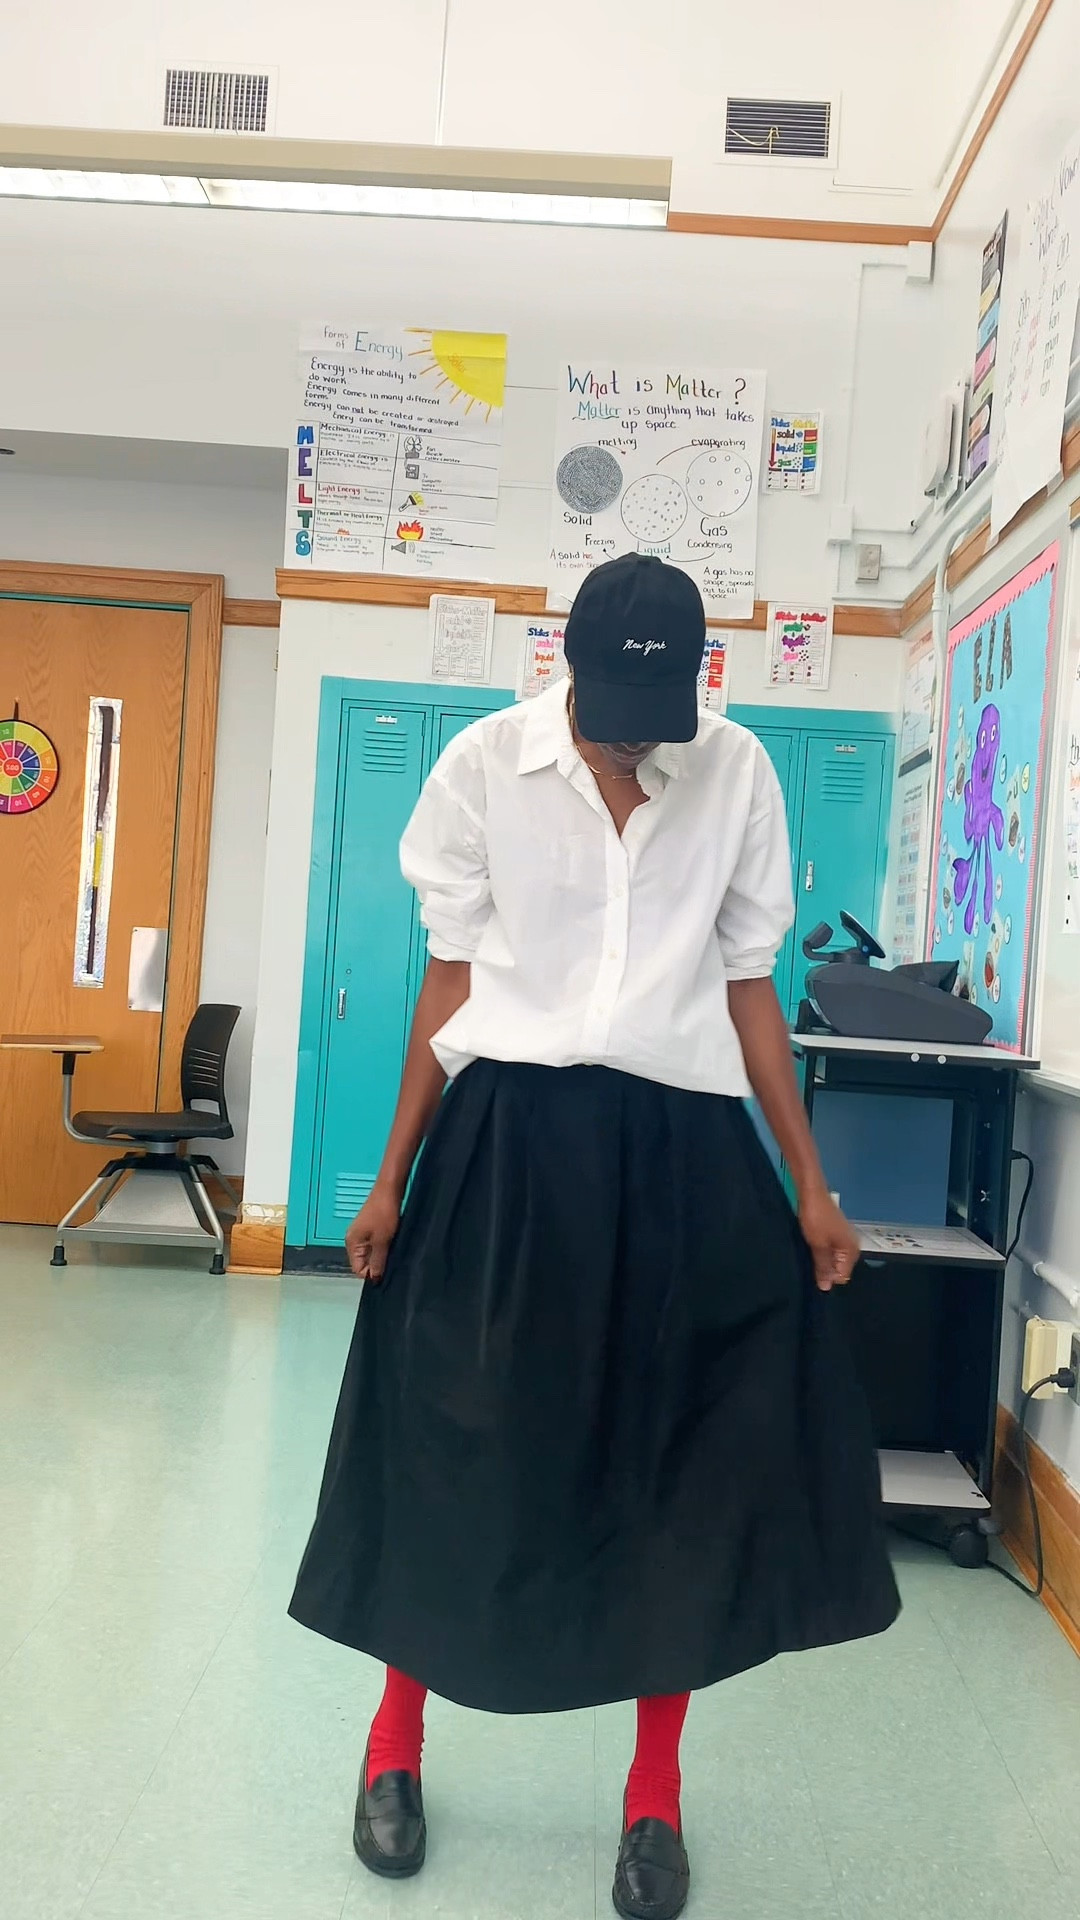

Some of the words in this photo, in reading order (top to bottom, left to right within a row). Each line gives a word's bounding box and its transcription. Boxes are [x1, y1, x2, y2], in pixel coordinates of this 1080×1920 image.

[354, 331, 403, 362] Energy
[310, 356, 345, 376] Energy
[361, 366, 375, 376] the
[376, 369, 404, 384] ability
[409, 372, 417, 380] to
[308, 373, 320, 381] do
[323, 376, 347, 385] work
[567, 365, 620, 400] What
[636, 377, 653, 392] is
[665, 374, 722, 401] Matter
[734, 377, 747, 405] ?
[307, 381, 337, 395] Energy
[342, 388, 368, 398] comes
[380, 394, 404, 404] many
[406, 394, 440, 405] different
[304, 399, 332, 411] Energy
[368, 407, 379, 415] be
[381, 411, 413, 421] created
[427, 417, 459, 427] destroyed
[575, 401, 622, 421] Matter
[628, 408, 641, 416] is
[646, 405, 692, 420] anything
[695, 406, 717, 418] that
[726, 407, 755, 424] takes
[374, 417, 385, 425] be
[621, 420, 638, 434] up
[297, 425, 315, 445] M
[776, 428, 796, 439] solid
[597, 438, 637, 451] melting
[776, 442, 796, 455] liquid
[320, 449, 356, 458] Electrical
[298, 447, 313, 477] E
[298, 483, 314, 504] L
[337, 486, 361, 495] Energy
[297, 509, 314, 528] T
[563, 511, 593, 527] Solid
[700, 516, 728, 537] Gas
[294, 530, 312, 557] S
[585, 533, 616, 550] Freezing
[636, 540, 671, 556] Liquid
[687, 538, 733, 554] Condensing
[549, 548, 557, 561] A
[703, 565, 711, 576] A
[712, 568, 728, 580] gas
[729, 567, 744, 576] has
[528, 627, 549, 637] States
[622, 638, 644, 651] New
[644, 640, 668, 656] York
[534, 651, 554, 664] liquid
[973, 610, 1013, 704] ELA
[535, 667, 550, 676] gas
